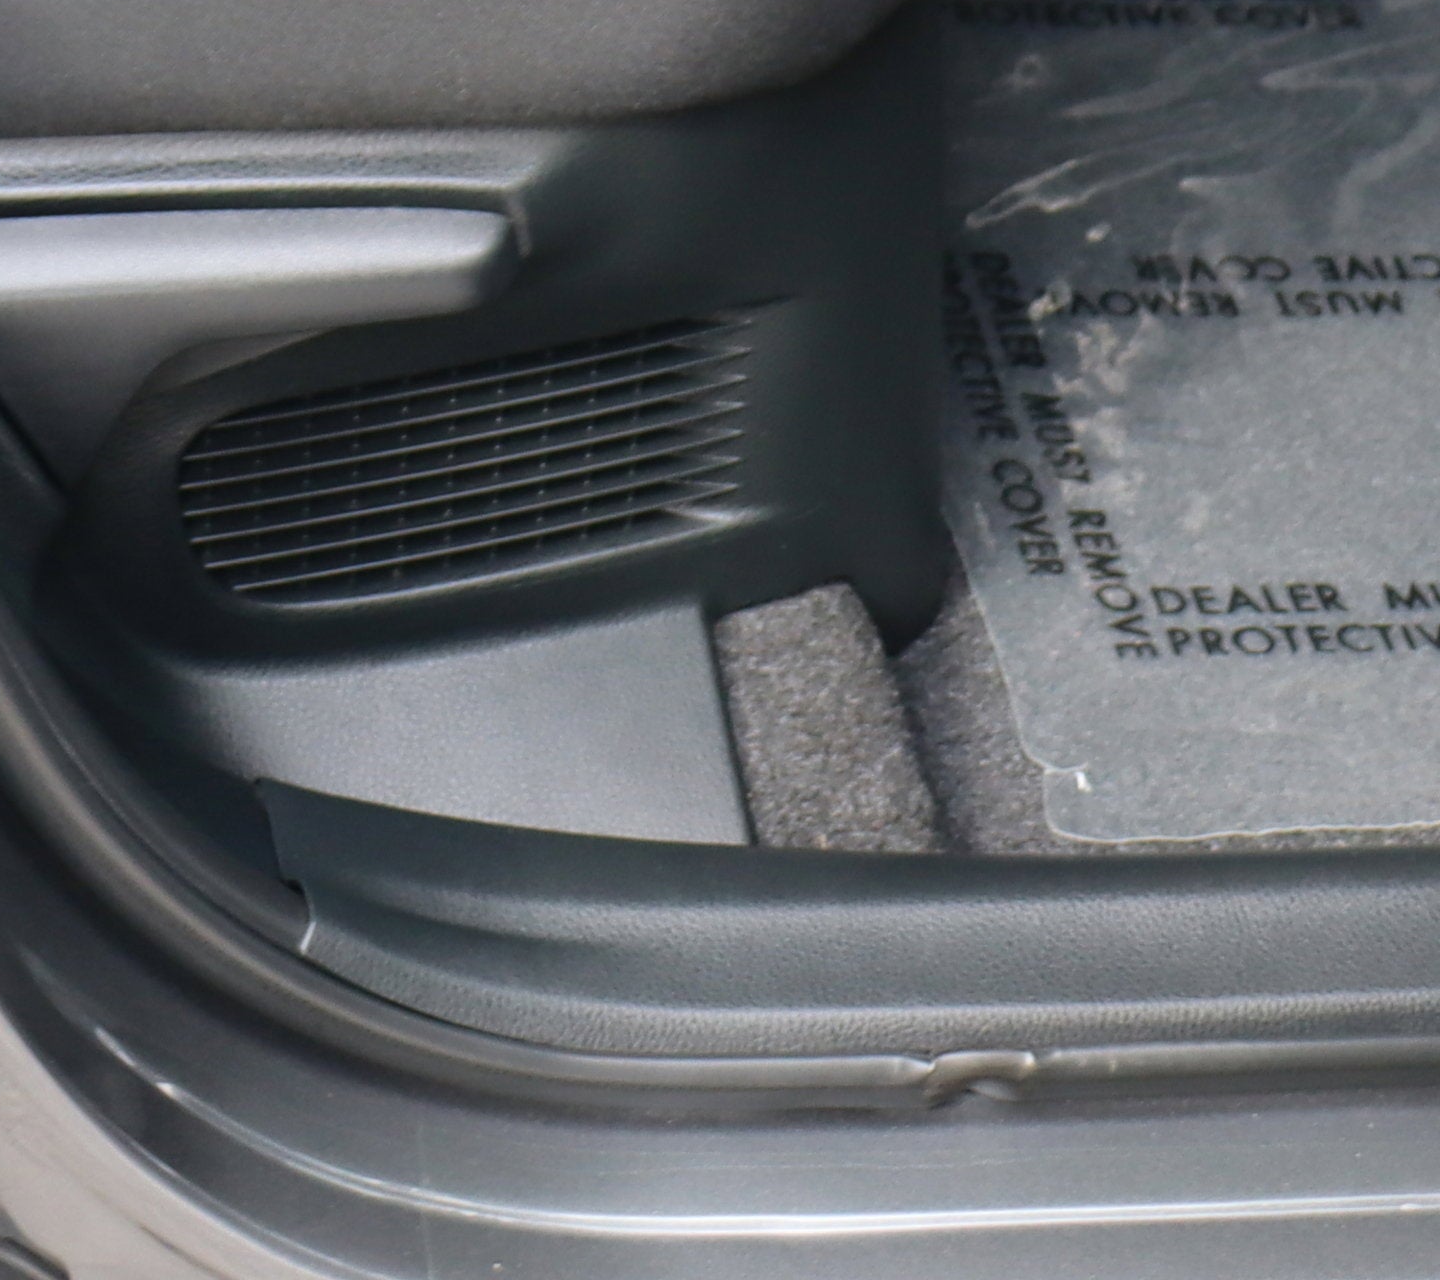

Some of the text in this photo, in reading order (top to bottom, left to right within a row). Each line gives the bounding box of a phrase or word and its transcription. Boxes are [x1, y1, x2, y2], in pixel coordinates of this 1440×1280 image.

[1274, 288, 1404, 320] MUST
[991, 456, 1065, 578] COVER
[1020, 390, 1094, 486] MUST
[1066, 507, 1160, 662] REMOVE
[1150, 580, 1348, 617] DEALER
